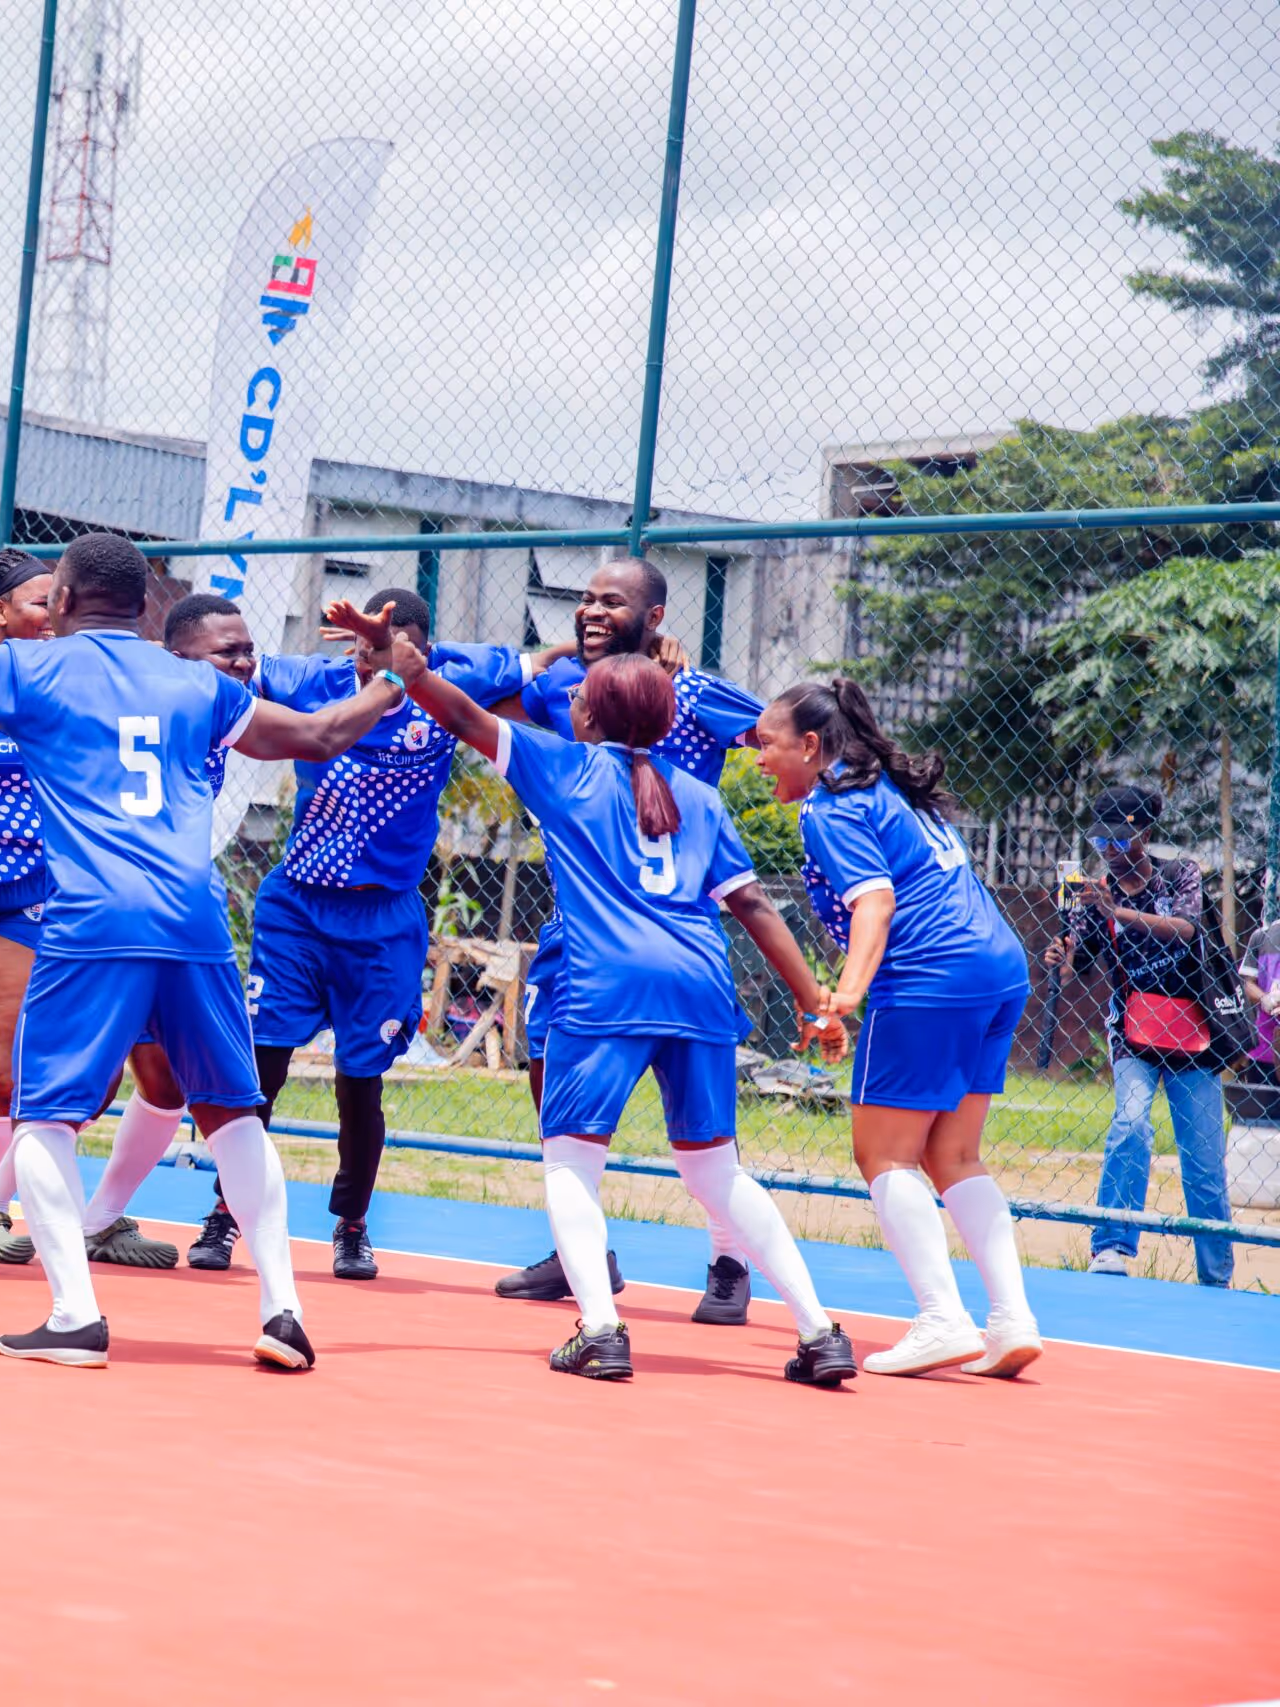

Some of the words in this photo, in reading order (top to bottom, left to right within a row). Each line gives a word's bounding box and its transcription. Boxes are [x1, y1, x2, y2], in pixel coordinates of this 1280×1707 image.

[118, 716, 163, 817] 5
[636, 824, 677, 895] 9
[247, 974, 265, 1016] 2
[524, 984, 540, 1025] 7
